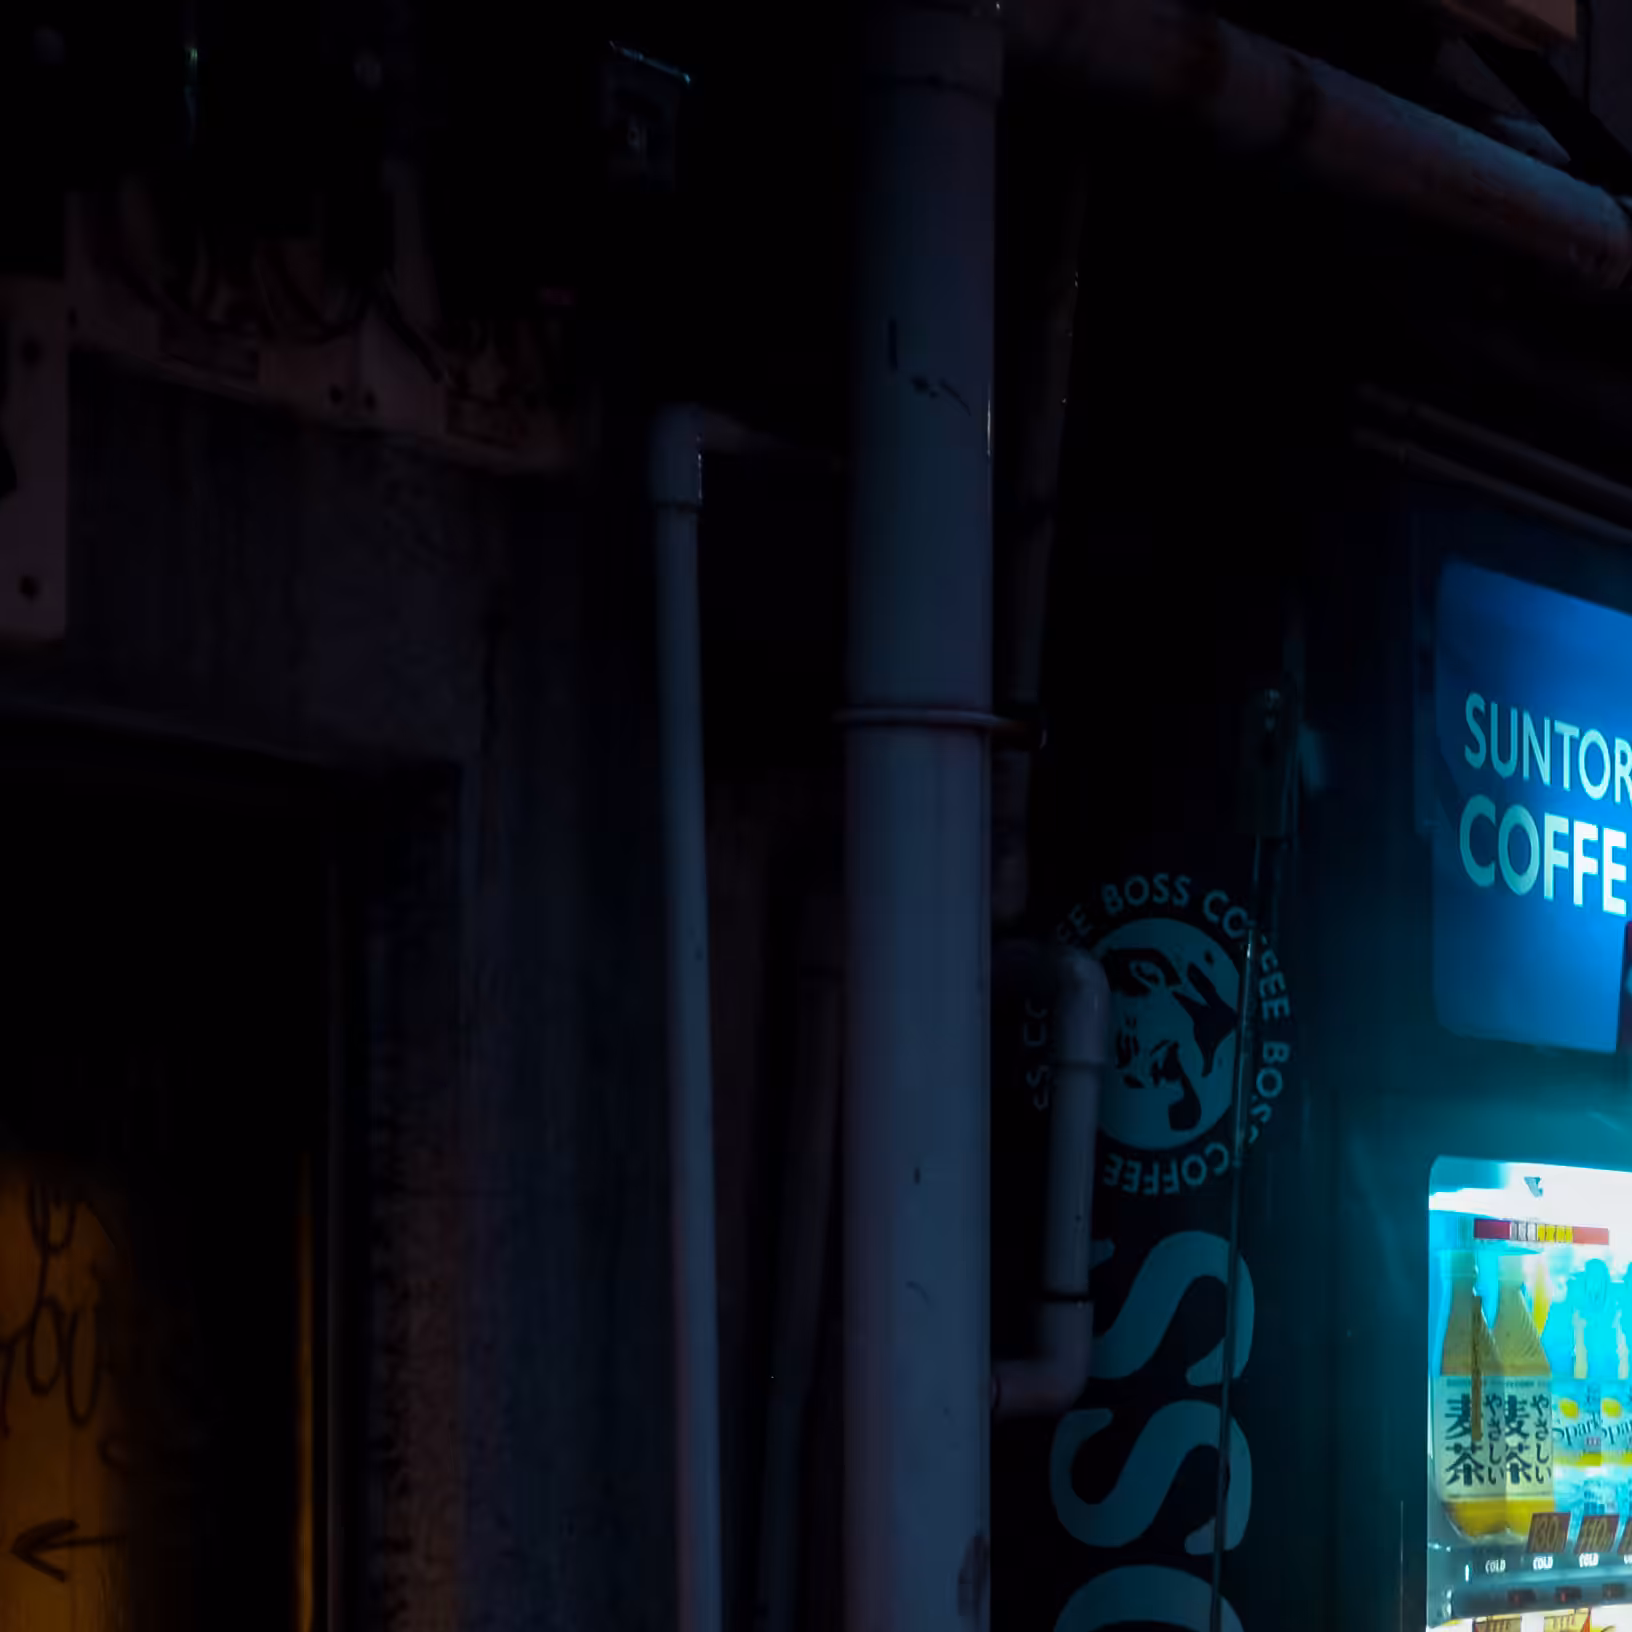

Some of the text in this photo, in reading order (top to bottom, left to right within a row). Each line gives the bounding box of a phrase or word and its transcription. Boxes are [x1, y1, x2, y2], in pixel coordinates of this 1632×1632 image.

[1101, 872, 1192, 917] BOSS
[1102, 1142, 1231, 1197] COFFEE
[1485, 1559, 1506, 1574] COLD
[1532, 1556, 1553, 1571] COLD
